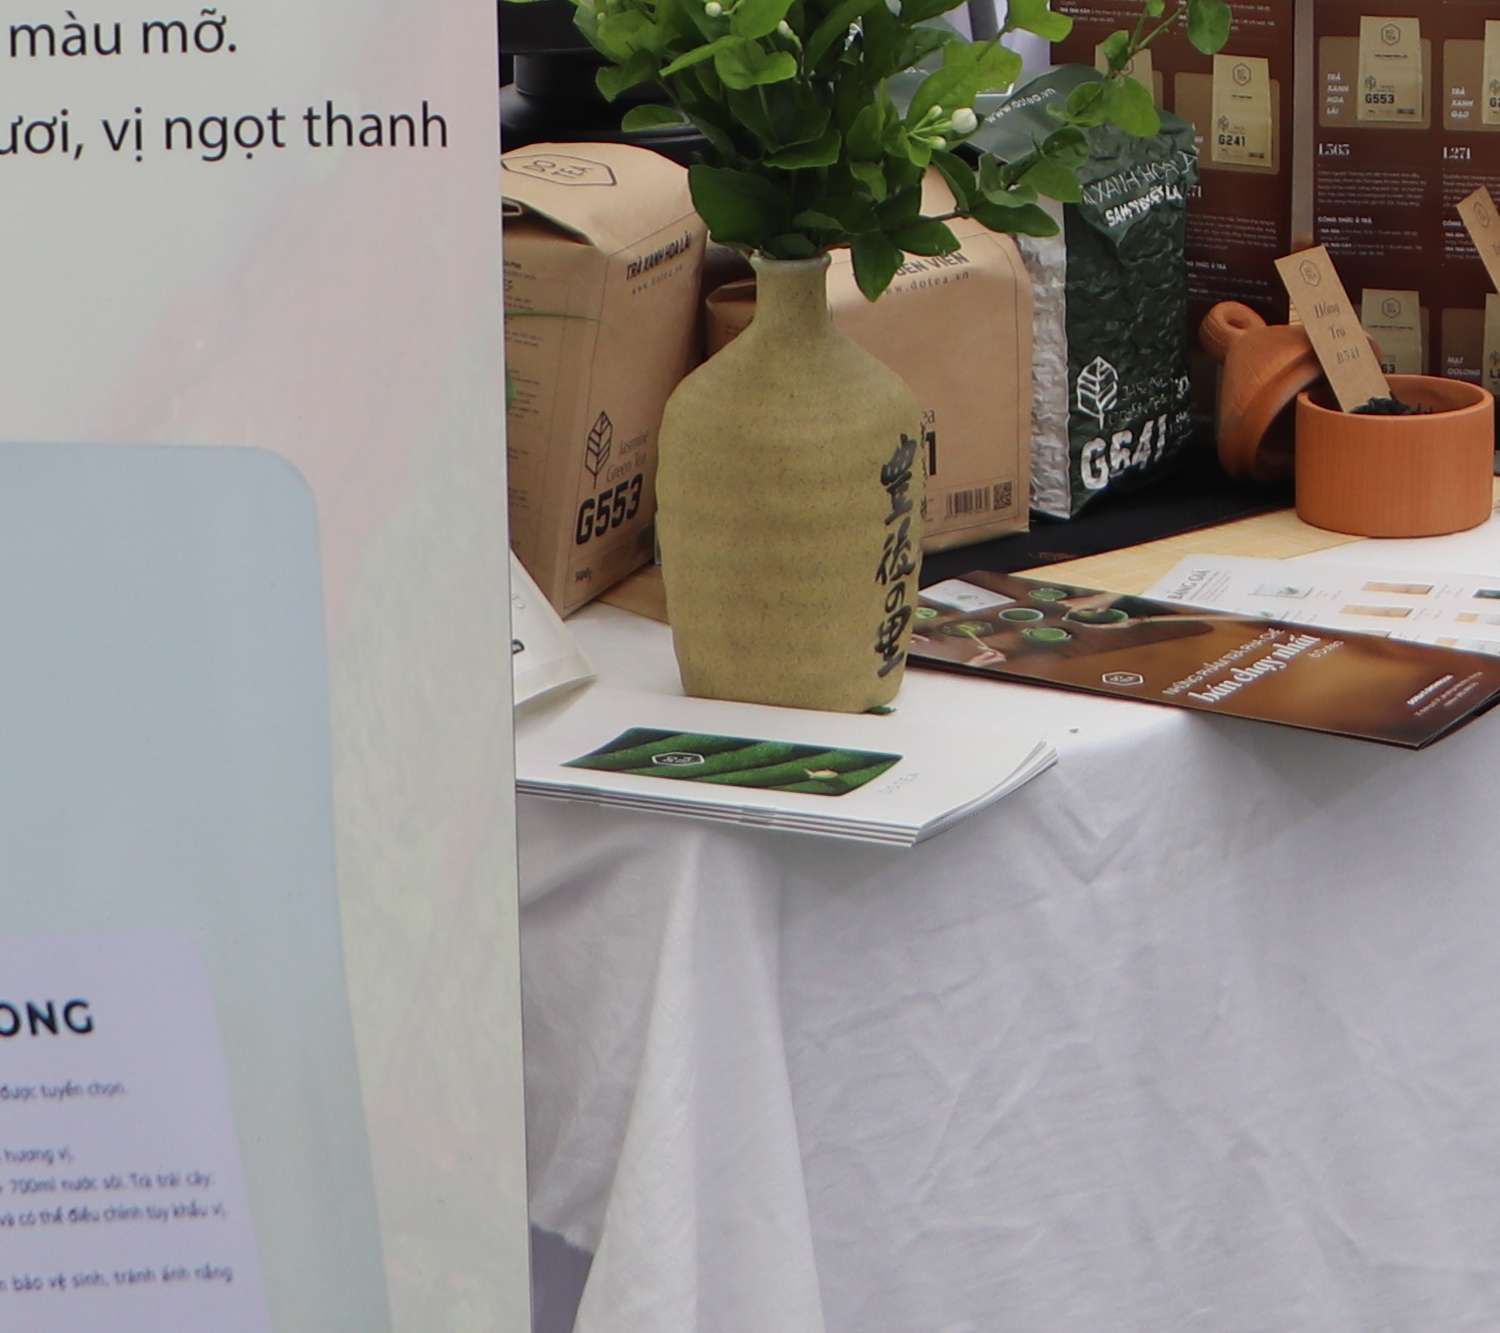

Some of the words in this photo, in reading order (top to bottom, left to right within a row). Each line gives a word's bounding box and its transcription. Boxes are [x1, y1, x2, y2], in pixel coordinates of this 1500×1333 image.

[1365, 93, 1395, 104] G553
[1218, 134, 1246, 148] G241
[1106, 202, 1133, 227] SAM
[618, 429, 650, 457] Jasmine
[606, 456, 633, 483] Green
[575, 473, 644, 546] G553
